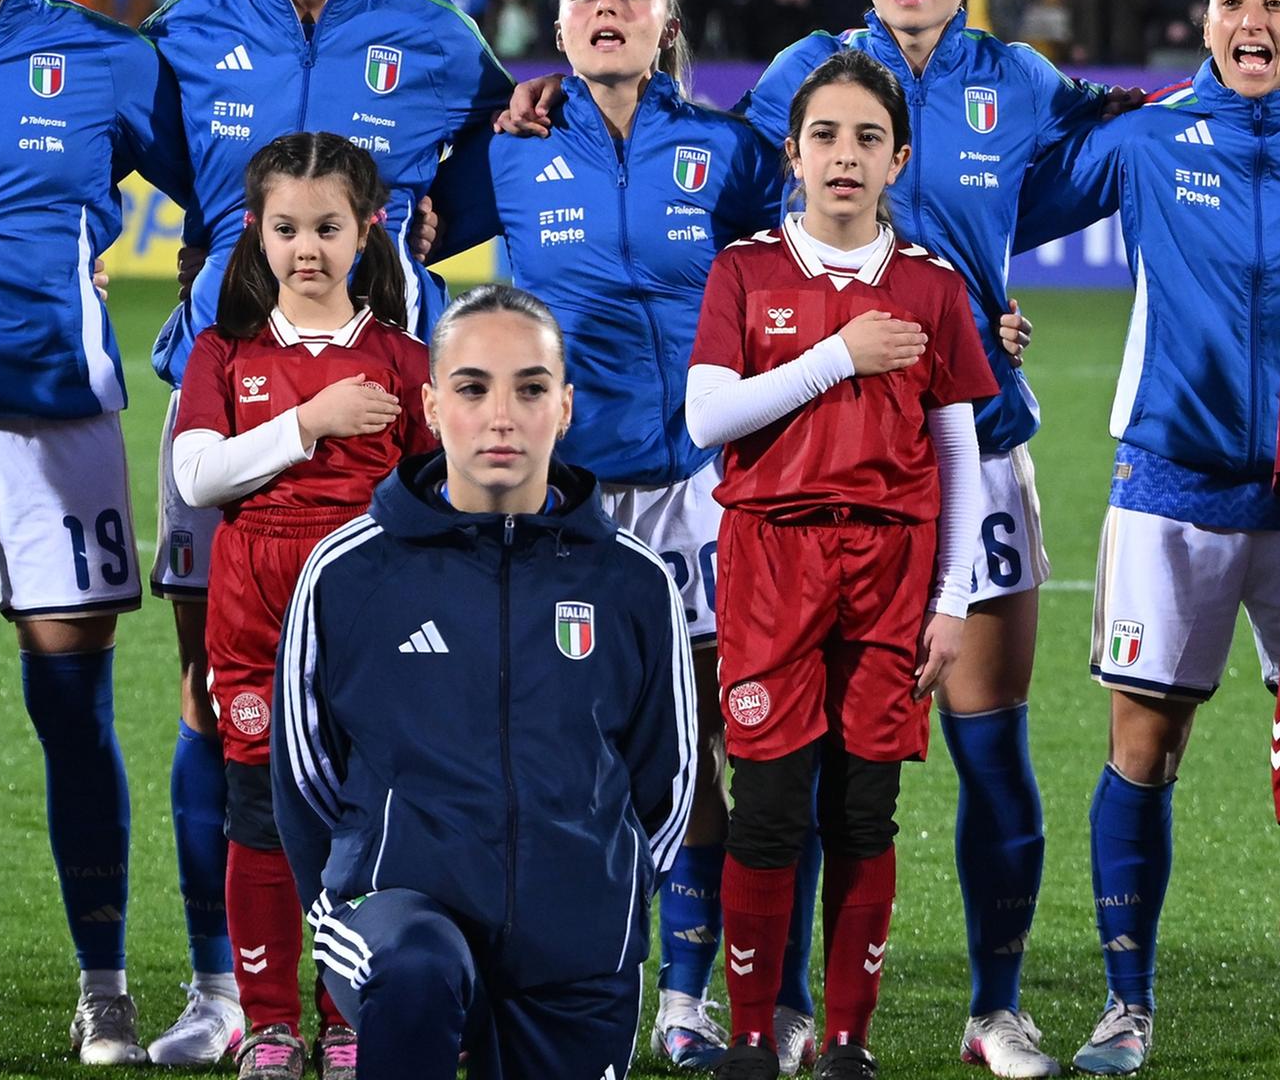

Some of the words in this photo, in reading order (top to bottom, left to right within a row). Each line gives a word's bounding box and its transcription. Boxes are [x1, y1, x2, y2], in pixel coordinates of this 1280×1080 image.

[33, 56, 61, 67] ITALIA
[371, 49, 398, 63] ITALIA
[968, 91, 994, 102] ITALIA
[228, 103, 254, 118] TIM
[28, 115, 67, 128] Telepass
[360, 113, 397, 128] Telepass
[210, 121, 251, 137] Poste
[18, 136, 45, 151] eni
[349, 136, 374, 150] eni
[679, 149, 707, 162] ITALIA
[967, 150, 1001, 163] Telepass
[959, 172, 983, 188] eni
[1192, 171, 1220, 187] TIM
[1176, 186, 1220, 207] Poste
[555, 208, 584, 222] TIM
[673, 205, 707, 217] Telepass
[541, 227, 585, 244] Poste
[667, 225, 691, 241] eni
[765, 324, 797, 335] hummel
[239, 392, 270, 404] hummel
[62, 507, 129, 592] 19
[970, 511, 1022, 595] 6
[559, 606, 591, 620] ITALIA
[1114, 623, 1141, 634] ITALIA
[736, 694, 762, 711] DBU
[238, 705, 262, 721] DBU
